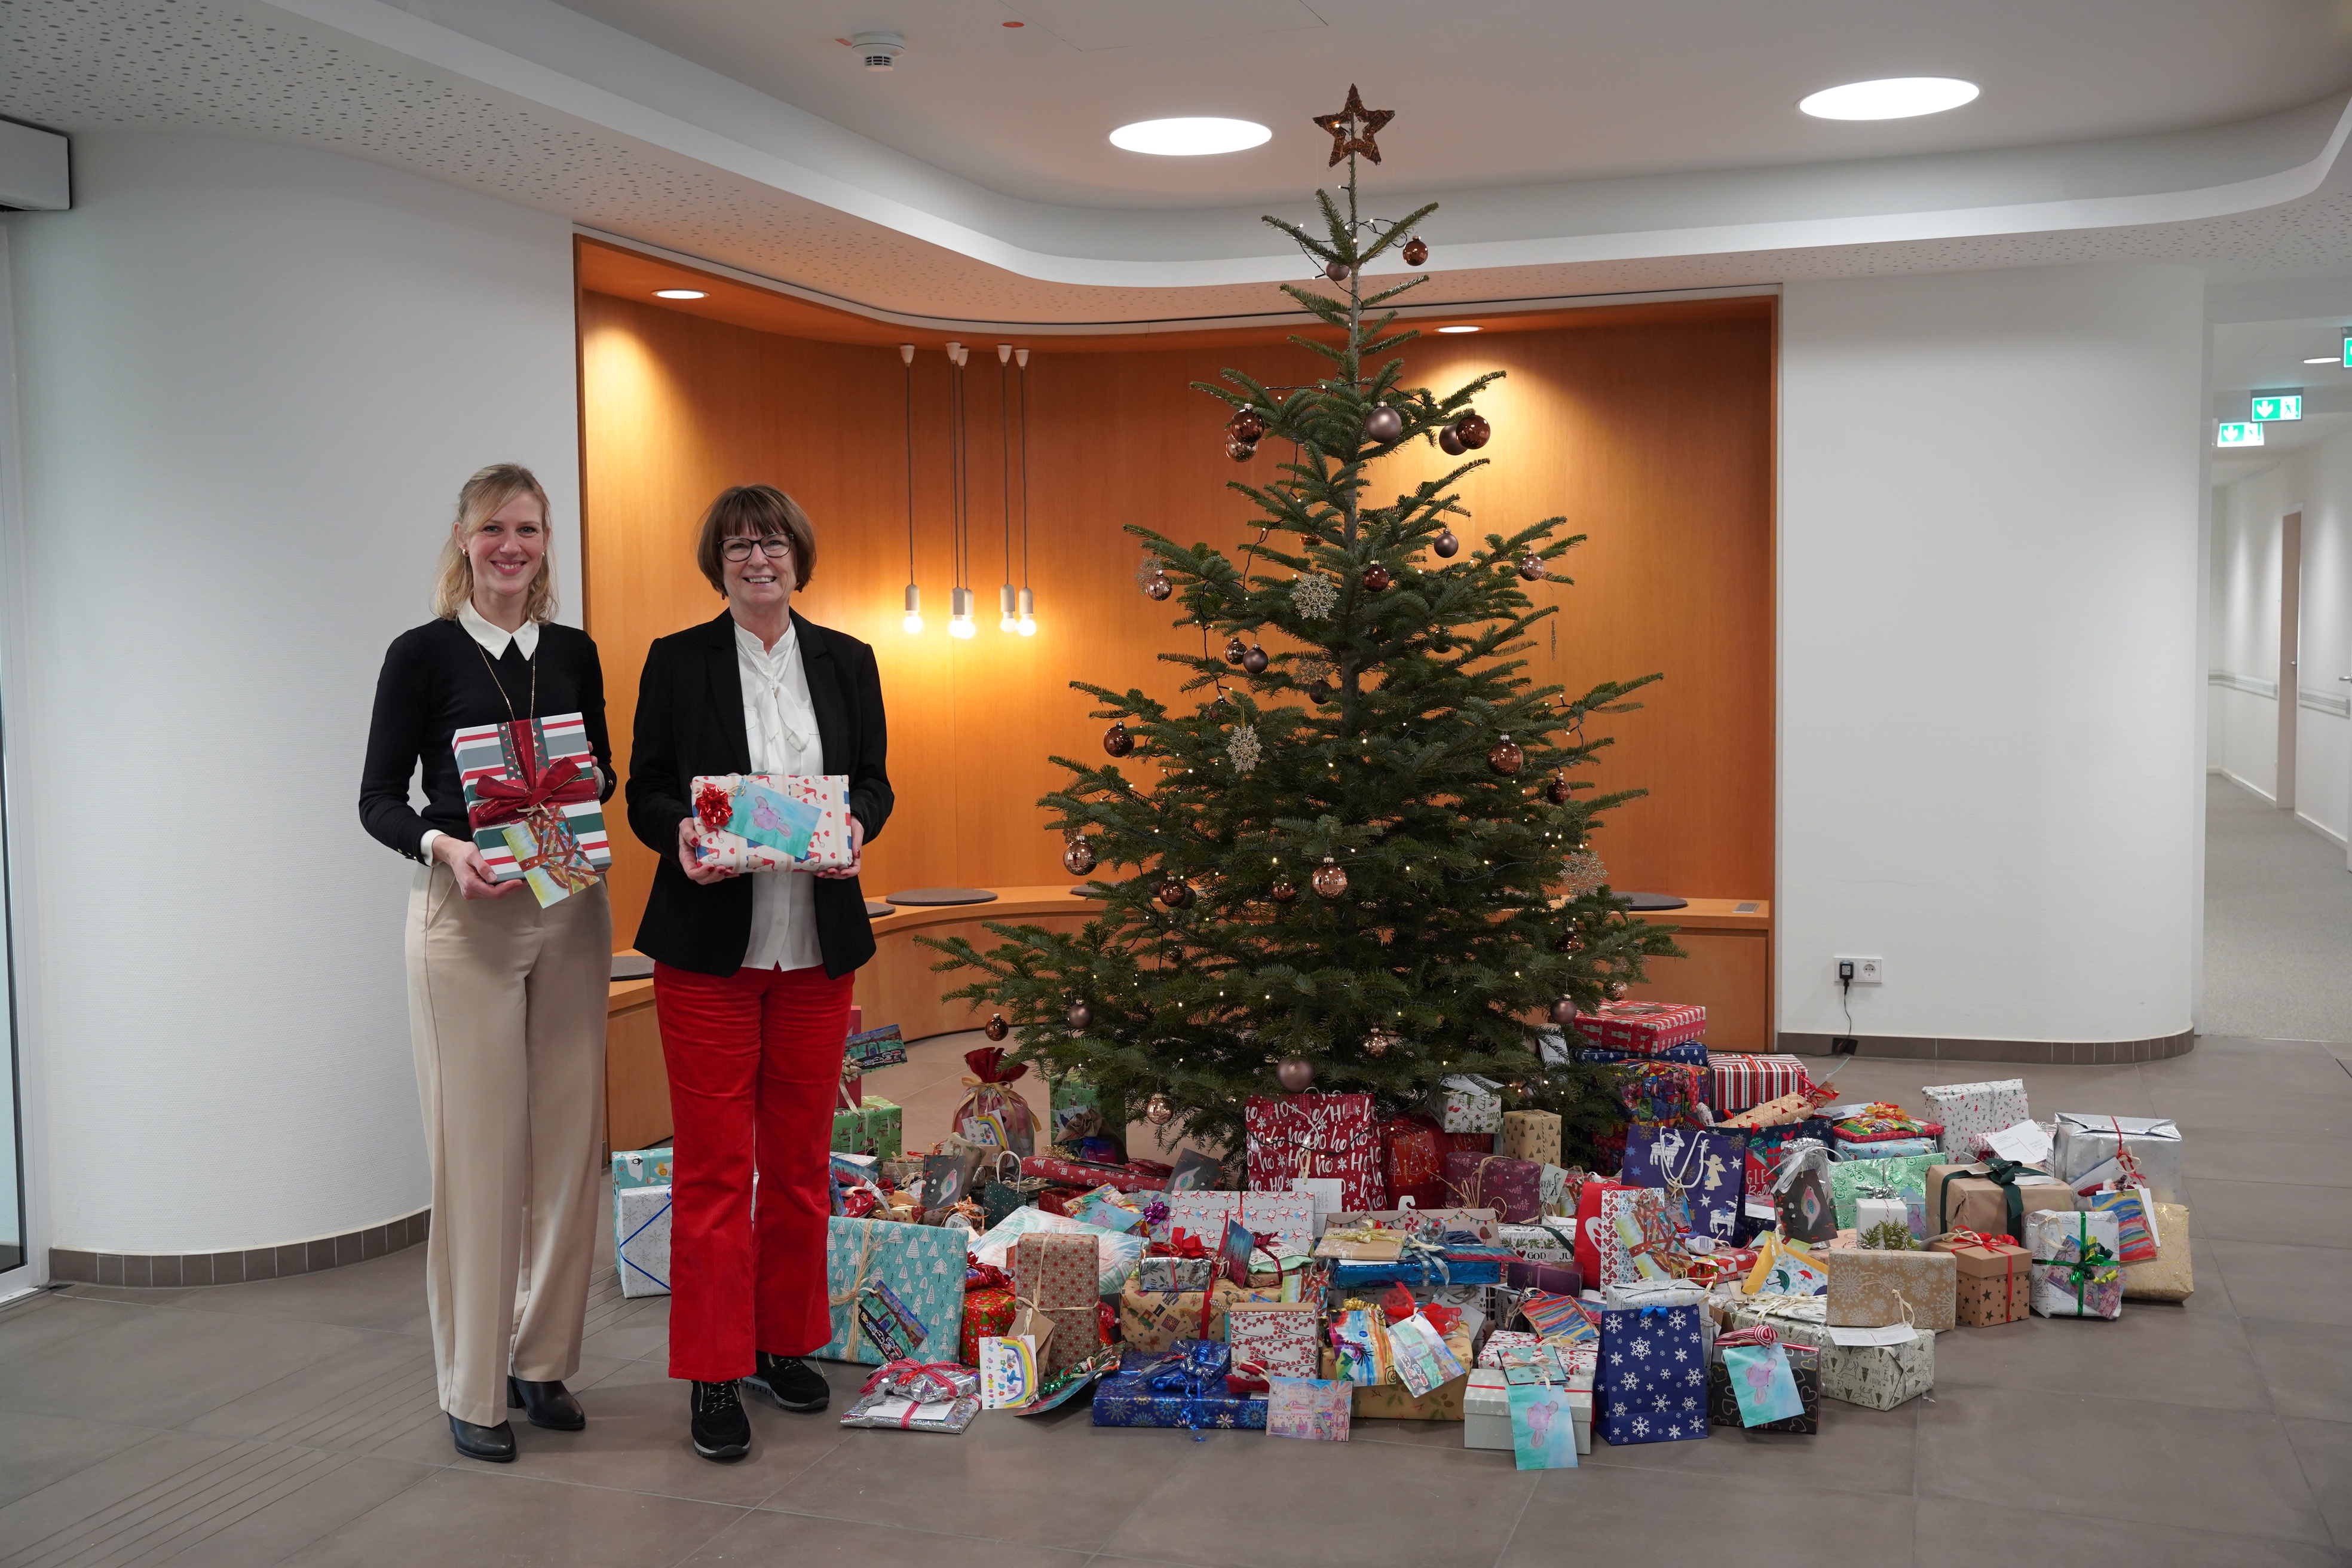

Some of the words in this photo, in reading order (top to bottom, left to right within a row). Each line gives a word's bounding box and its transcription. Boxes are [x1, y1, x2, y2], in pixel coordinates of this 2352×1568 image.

[1258, 1152, 1274, 1172] ho
[1315, 1154, 1333, 1176] ho
[1870, 1377, 1881, 1387] MERRY
